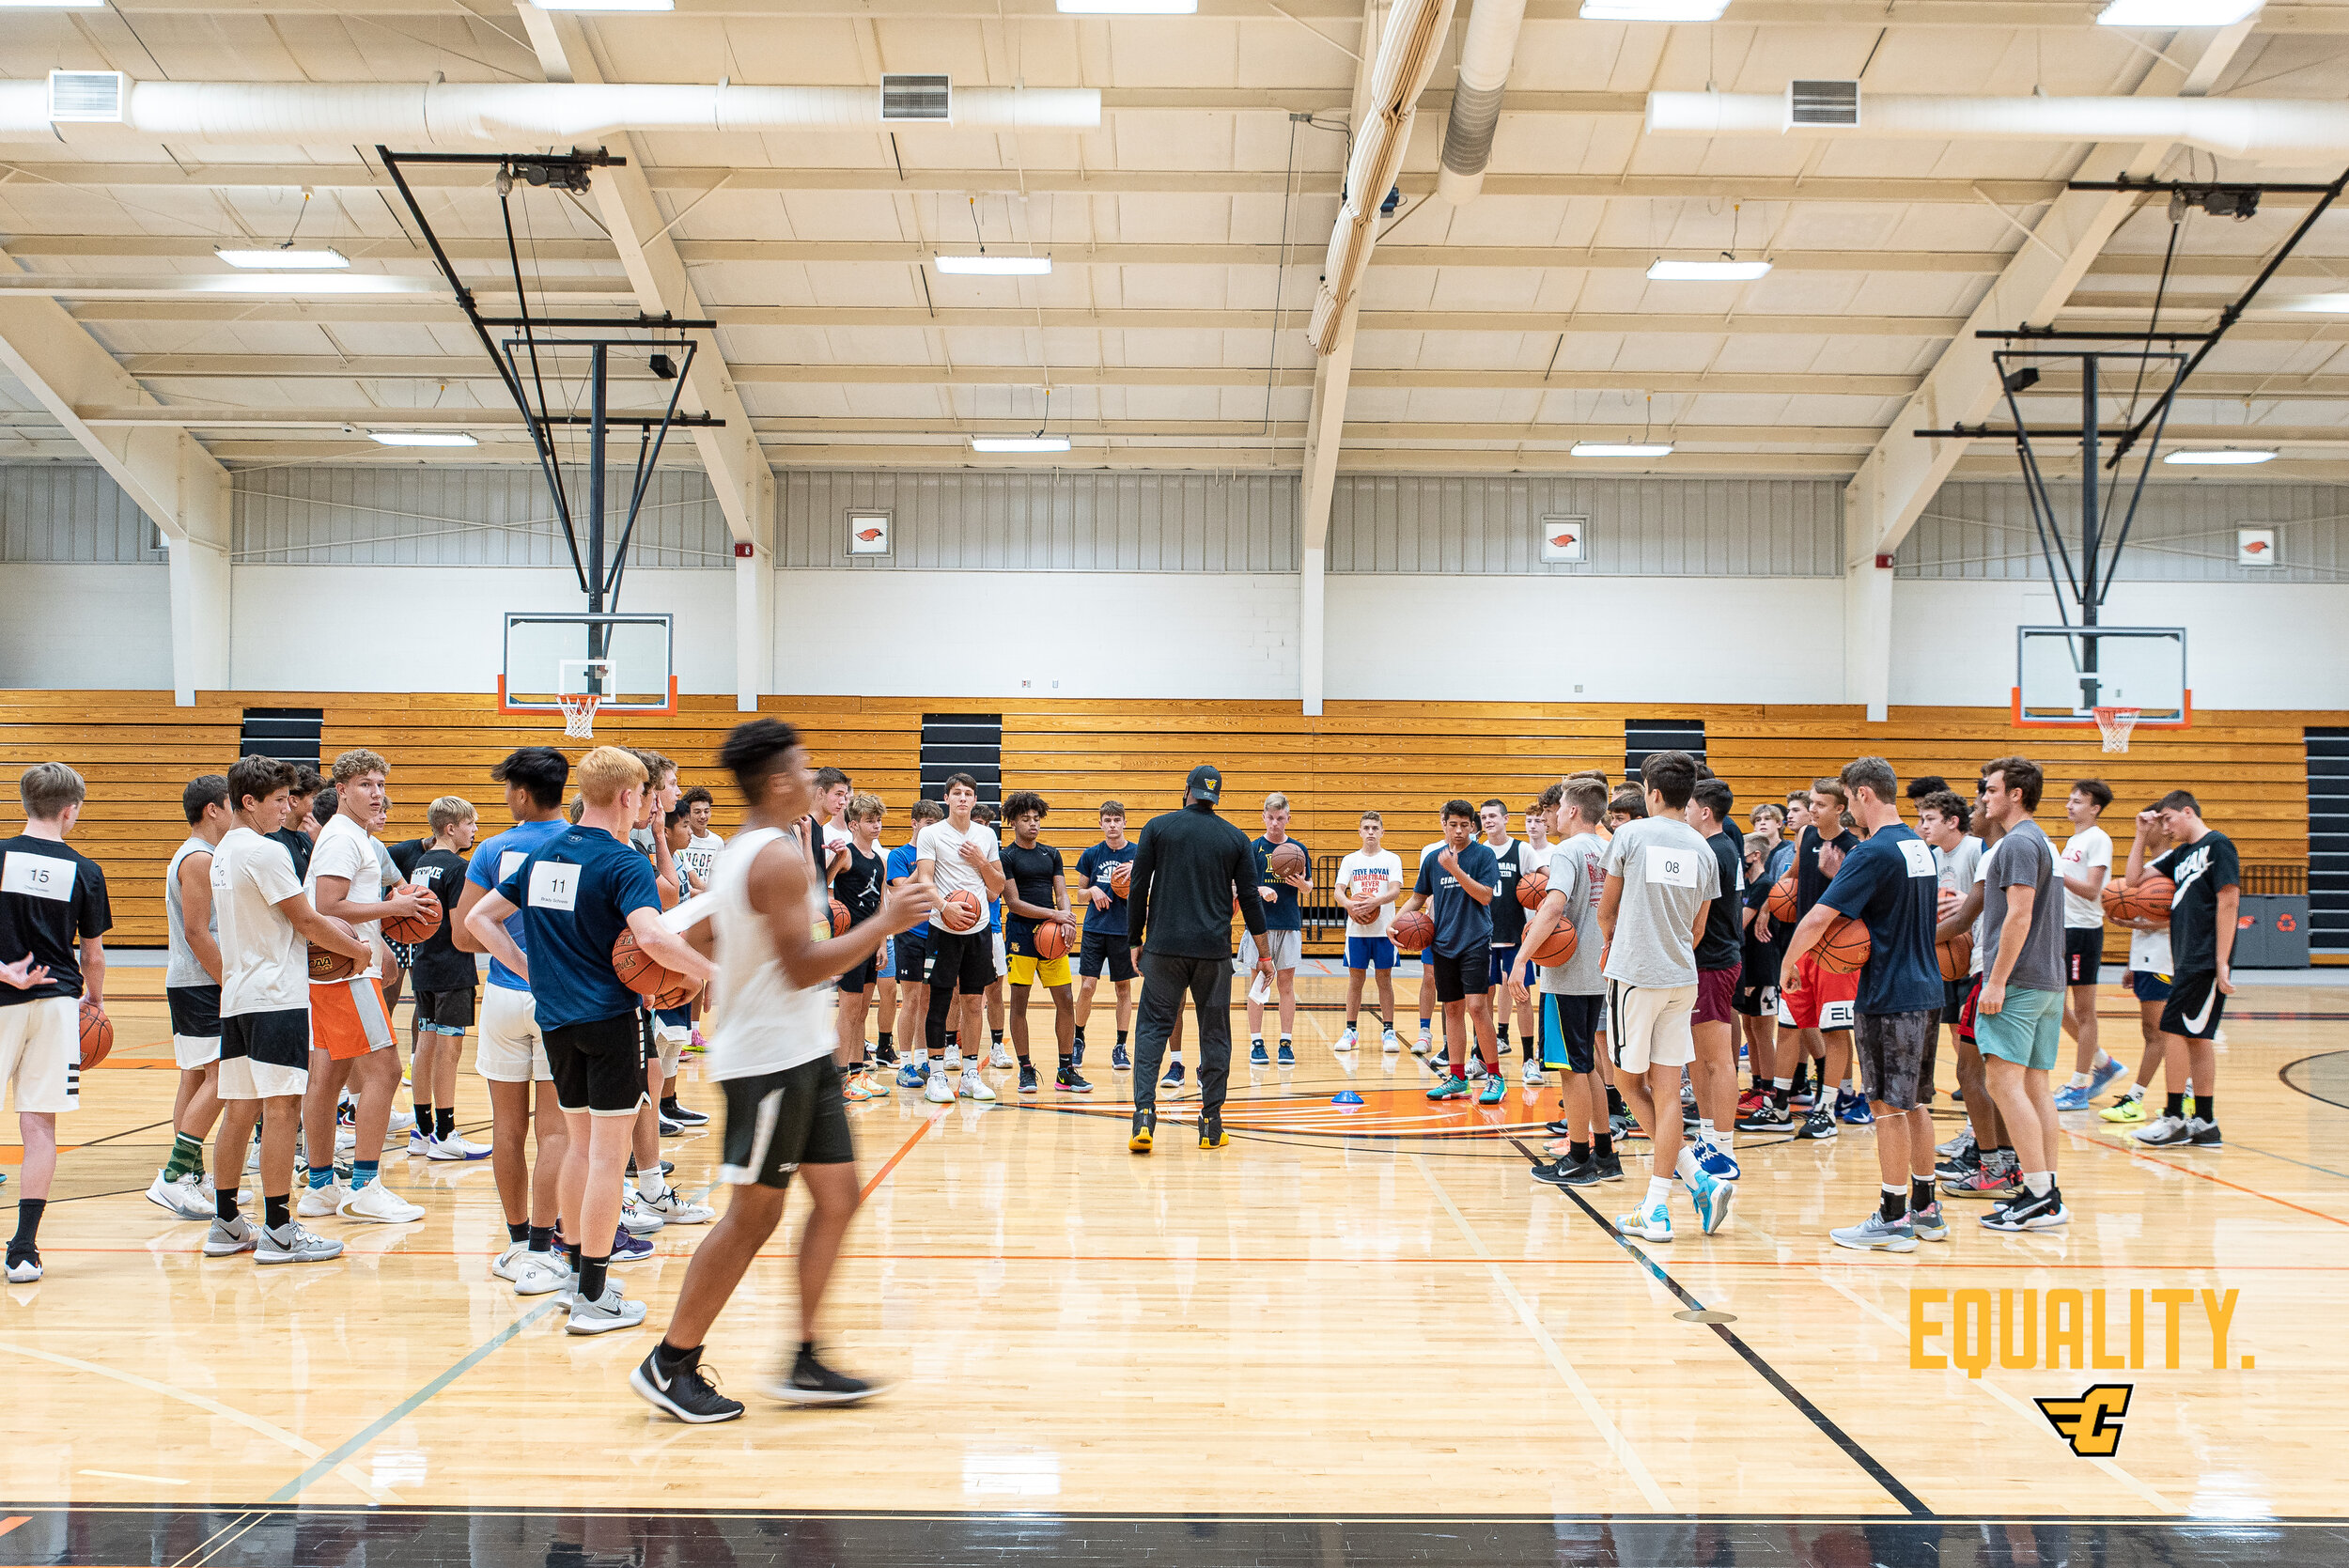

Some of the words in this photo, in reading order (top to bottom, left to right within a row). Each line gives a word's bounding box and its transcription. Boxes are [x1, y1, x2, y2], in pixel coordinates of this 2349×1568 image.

[1498, 862, 1517, 872] MAN
[1665, 861, 1680, 874] 08
[30, 869, 50, 883] 15
[552, 878, 566, 893] 11
[307, 955, 332, 969] CAA
[1831, 1007, 1853, 1020] EL
